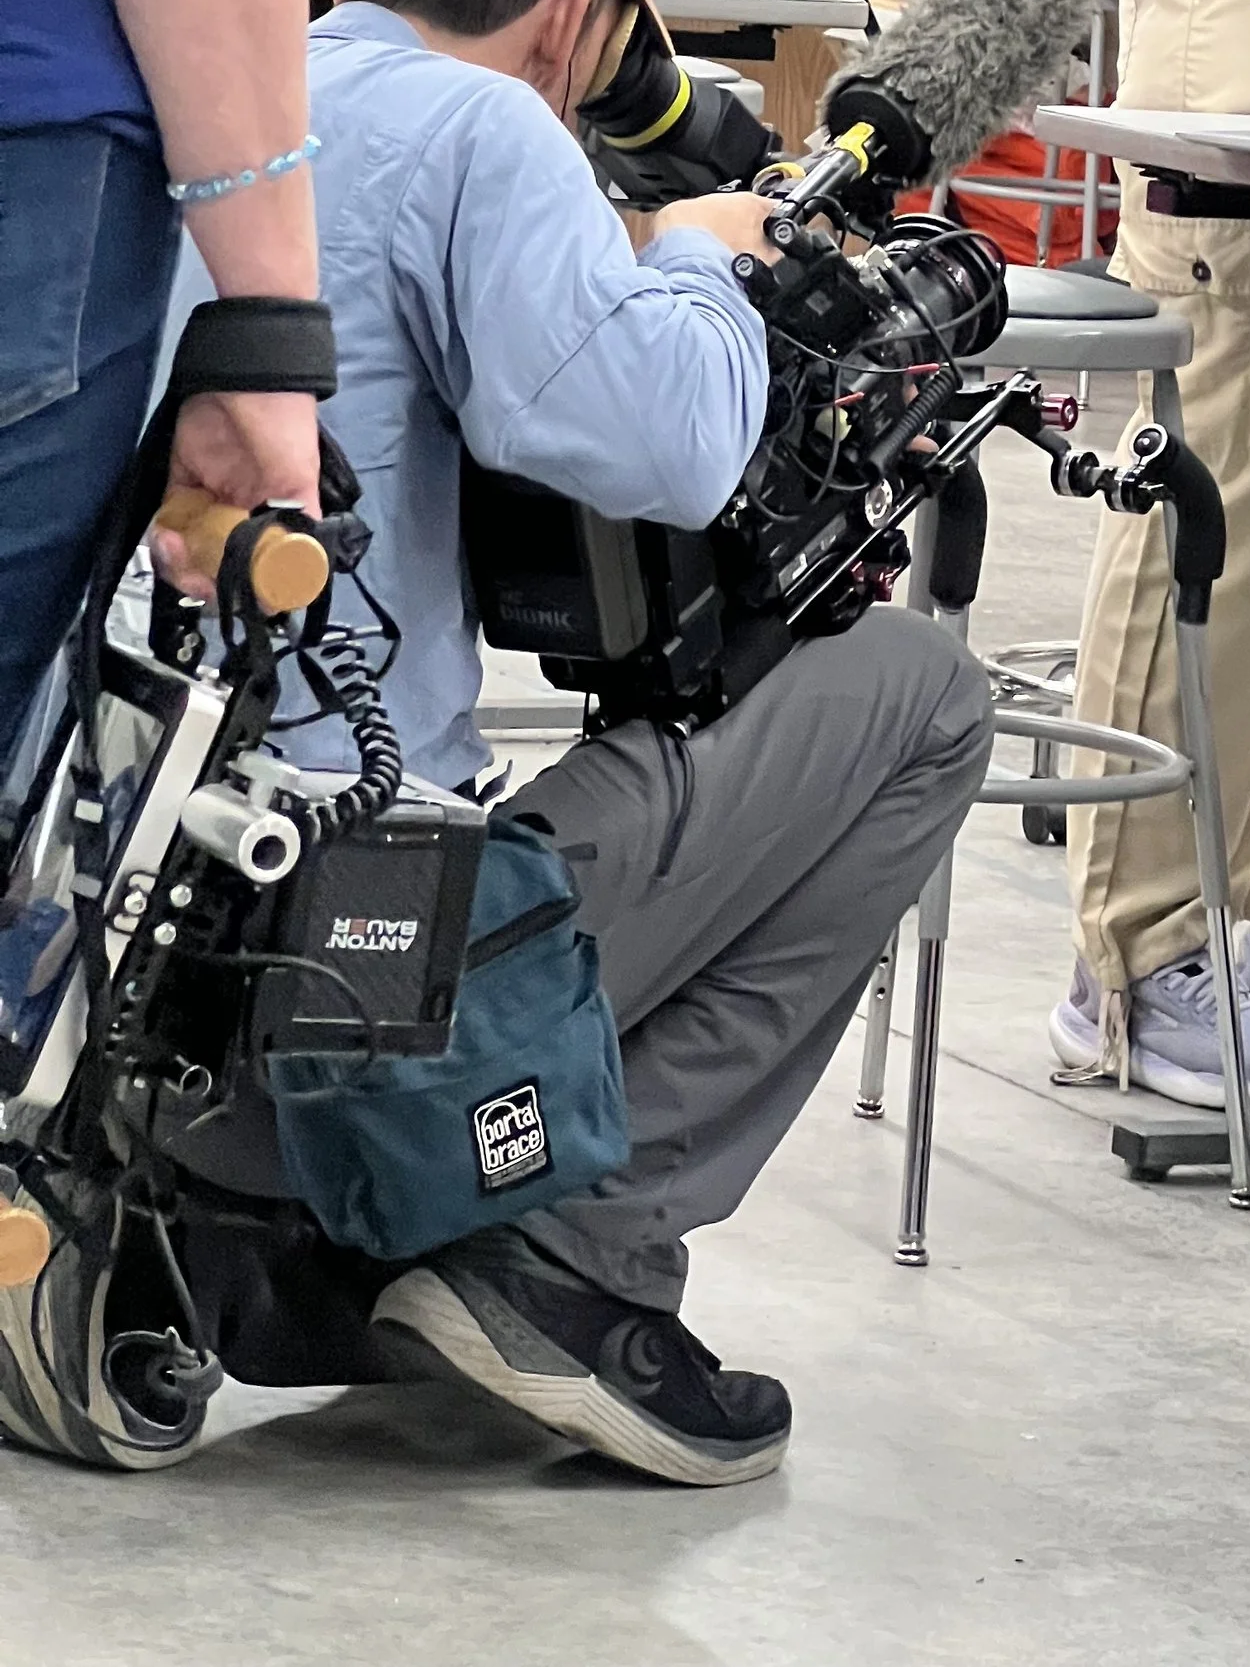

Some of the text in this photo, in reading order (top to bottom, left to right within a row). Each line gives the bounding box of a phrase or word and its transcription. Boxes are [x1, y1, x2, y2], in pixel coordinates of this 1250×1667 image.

[333, 917, 418, 936] BAUER
[329, 933, 415, 952] ANTON
[481, 1104, 537, 1146] porta
[486, 1129, 541, 1169] brace
